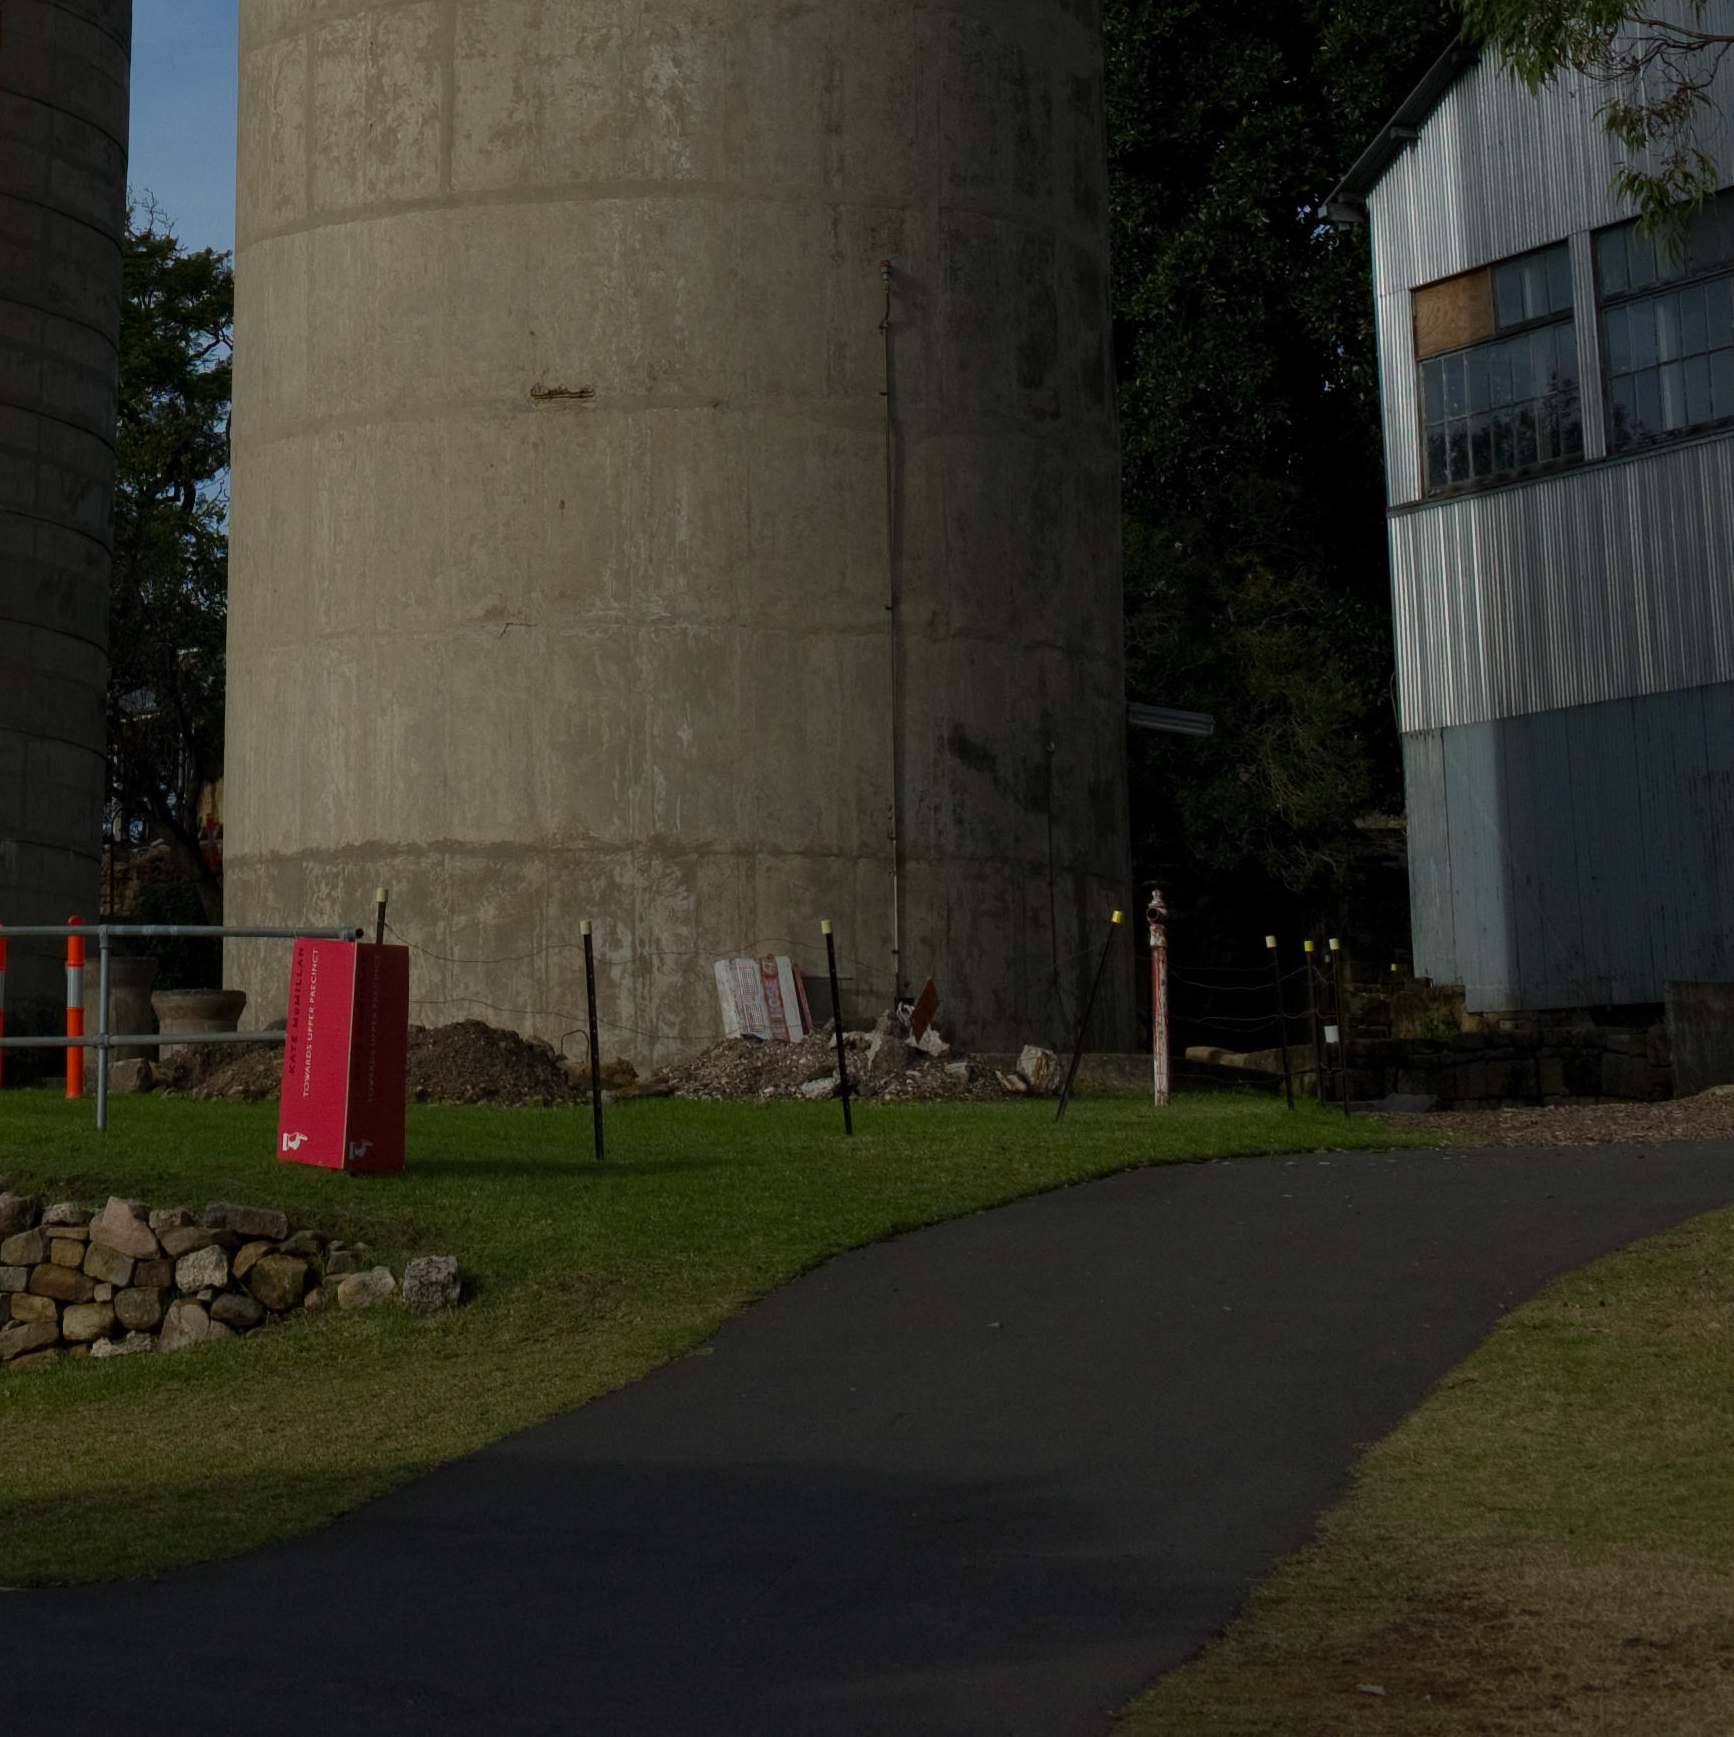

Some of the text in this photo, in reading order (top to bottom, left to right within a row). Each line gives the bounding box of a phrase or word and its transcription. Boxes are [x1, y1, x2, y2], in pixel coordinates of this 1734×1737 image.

[303, 948, 319, 1097] TOWARDS UPPER PRECINCT
[289, 1035, 298, 1074] KATE
[368, 1050, 377, 1102] TOWARDS
